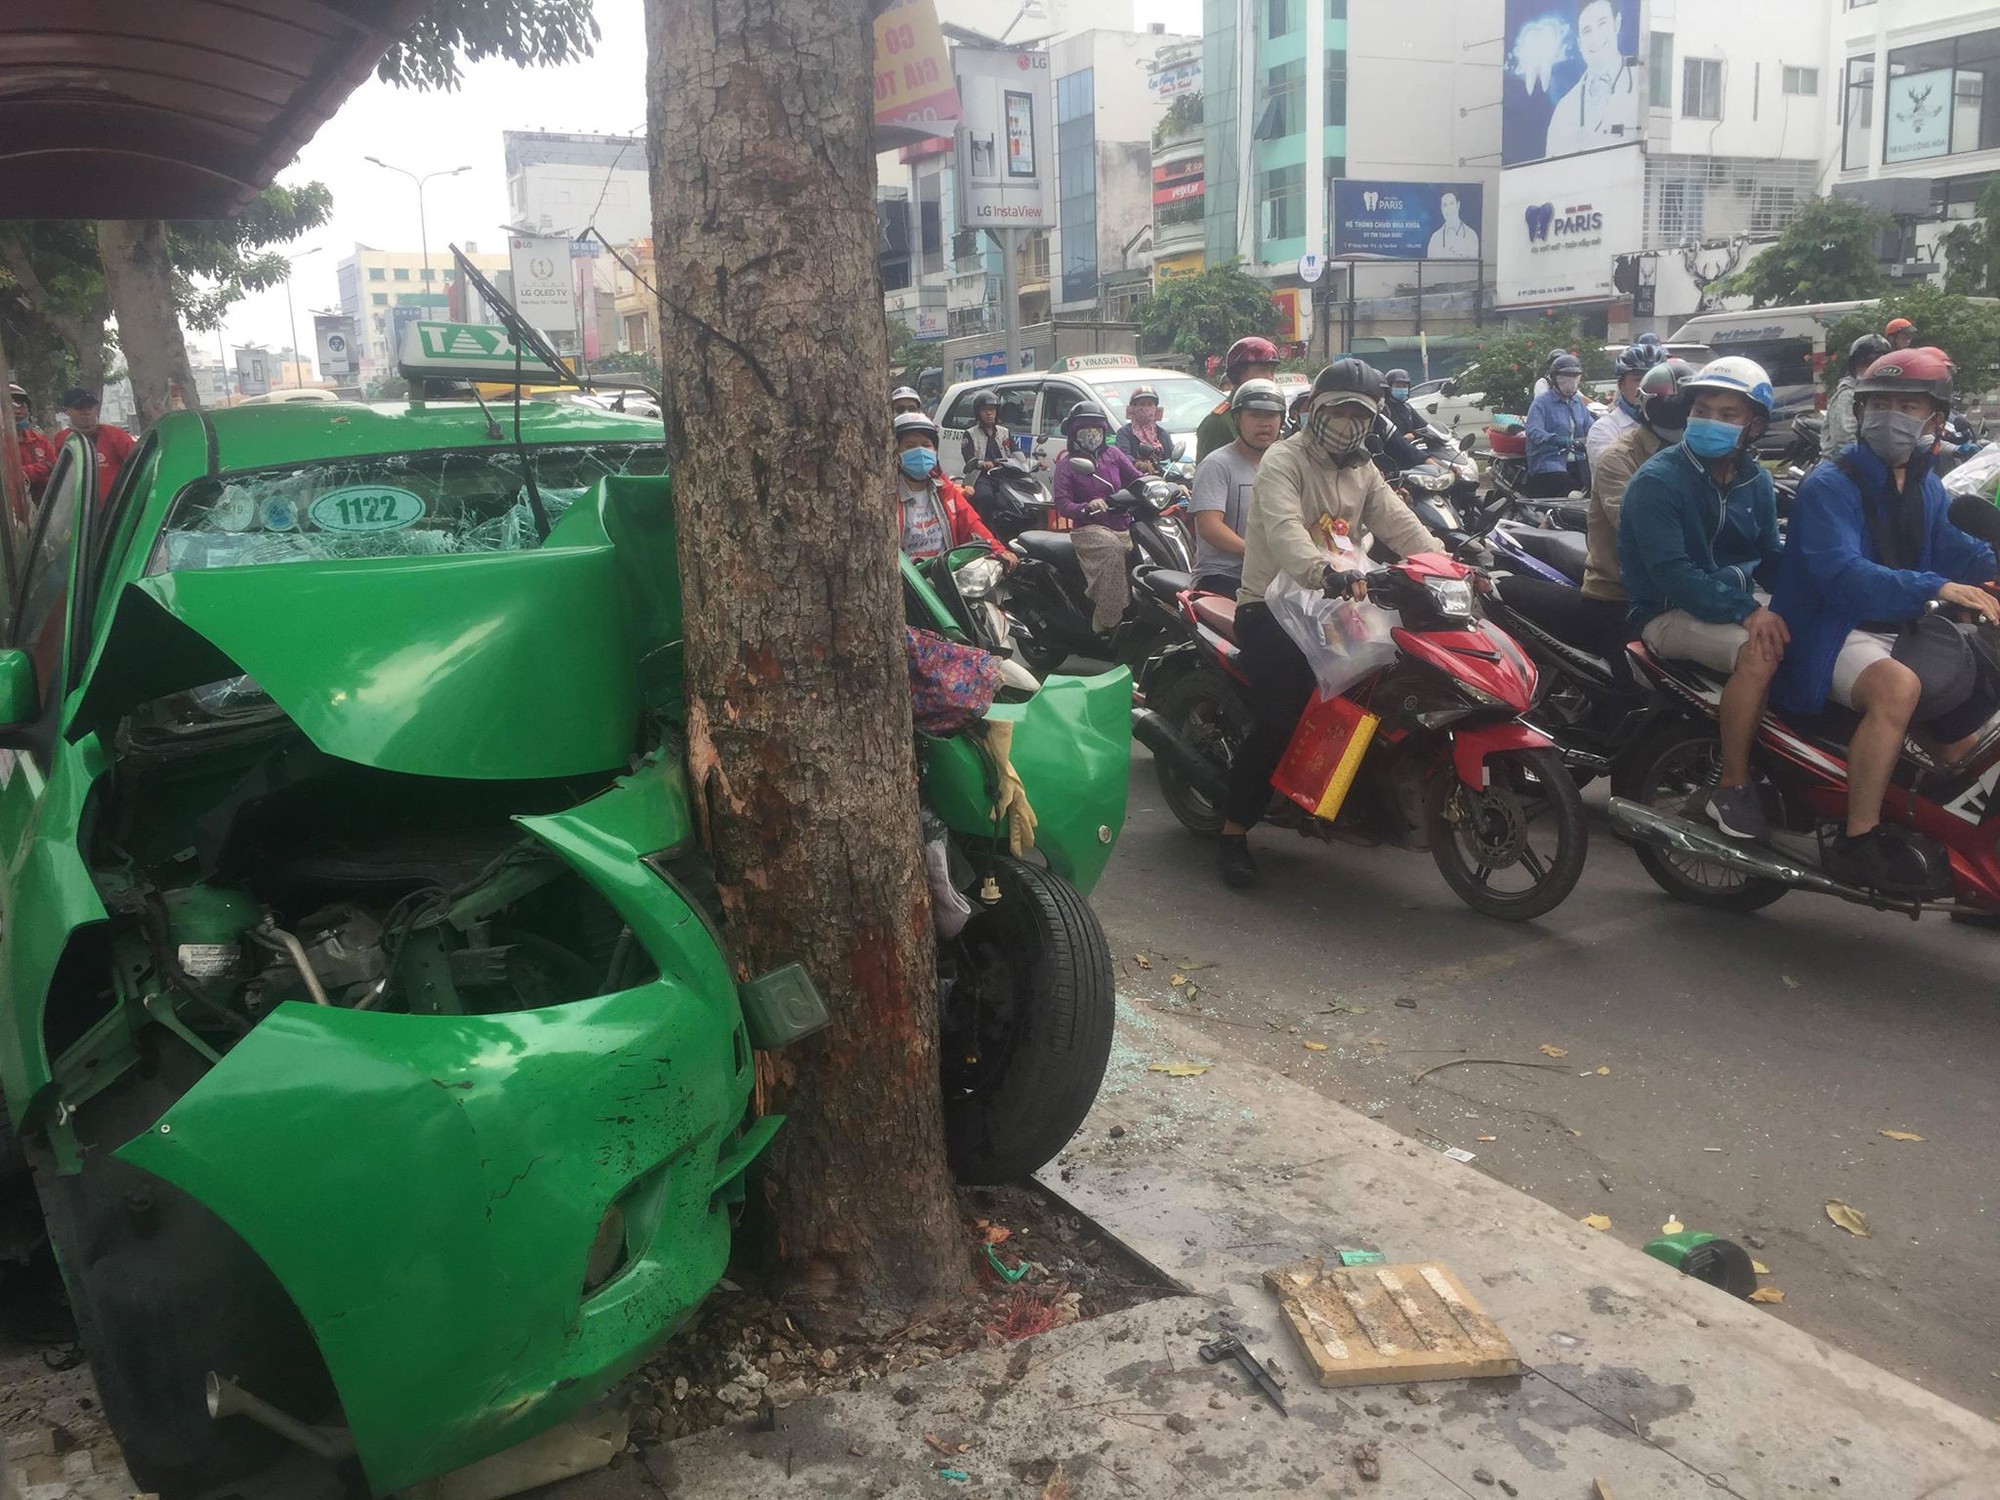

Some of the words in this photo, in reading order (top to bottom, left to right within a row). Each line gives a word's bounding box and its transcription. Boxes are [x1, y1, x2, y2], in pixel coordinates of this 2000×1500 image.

[1032, 57, 1047, 69] LG
[977, 205, 992, 217] LG
[994, 205, 1042, 217] InstaView
[1379, 200, 1404, 210] PARIS
[1554, 212, 1603, 236] PARIS
[520, 289, 531, 297] LG
[533, 289, 555, 297] OLED
[1083, 356, 1119, 366] VINASUN
[1120, 356, 1136, 365] TAXI
[335, 495, 398, 525] 1122
